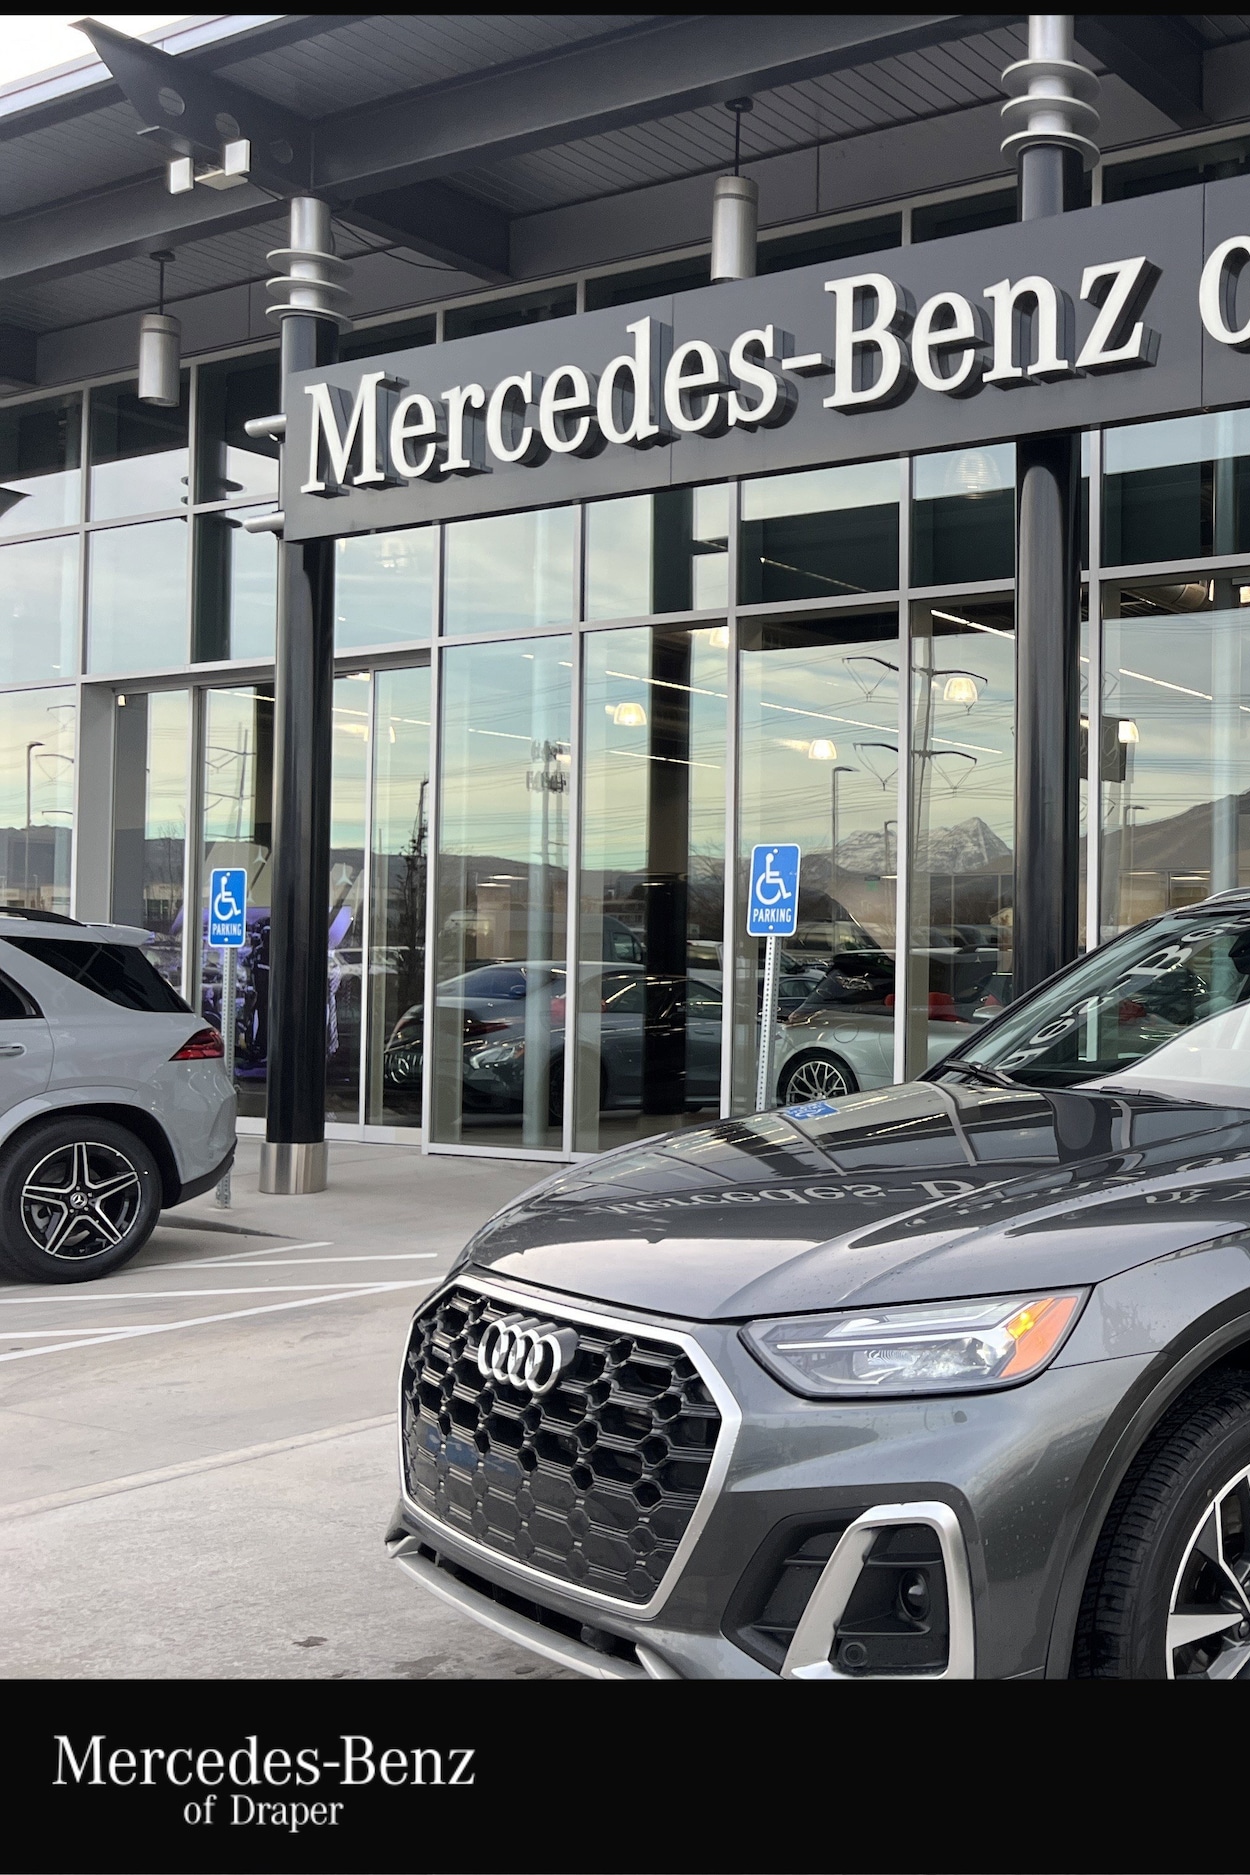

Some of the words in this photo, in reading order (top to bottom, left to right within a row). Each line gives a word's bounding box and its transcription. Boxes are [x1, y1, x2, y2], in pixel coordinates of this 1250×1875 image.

[300, 255, 1148, 495] Mercedes-Benz
[751, 907, 793, 923] PARKING
[211, 922, 242, 936] PARKING
